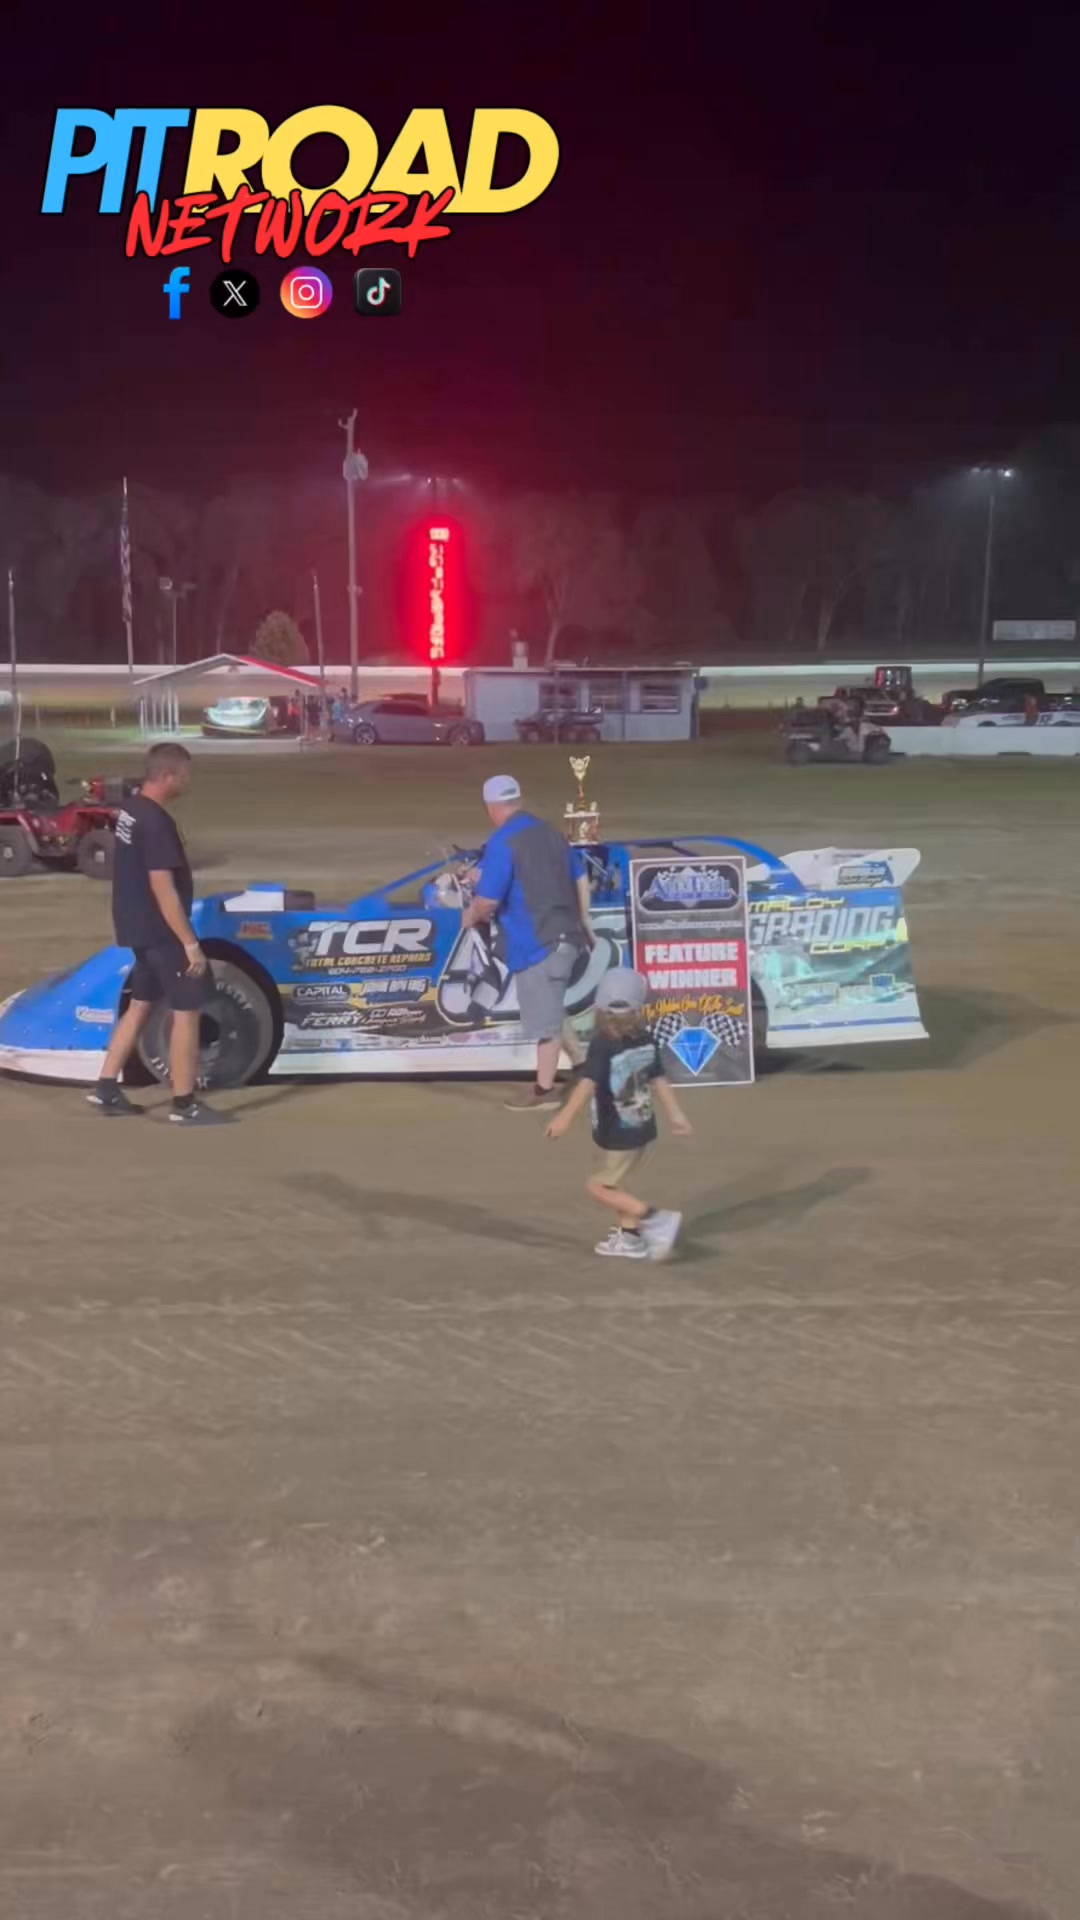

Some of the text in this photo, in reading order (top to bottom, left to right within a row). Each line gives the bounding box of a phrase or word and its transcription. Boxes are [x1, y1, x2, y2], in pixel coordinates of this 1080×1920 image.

[750, 905, 896, 946] GRADING
[307, 918, 433, 957] TCR
[389, 952, 433, 964] REPAIRS
[643, 942, 739, 964] FEATURE
[647, 968, 738, 990] WINNER
[296, 985, 348, 997] CAPITAL
[301, 1015, 362, 1026] FERRY
